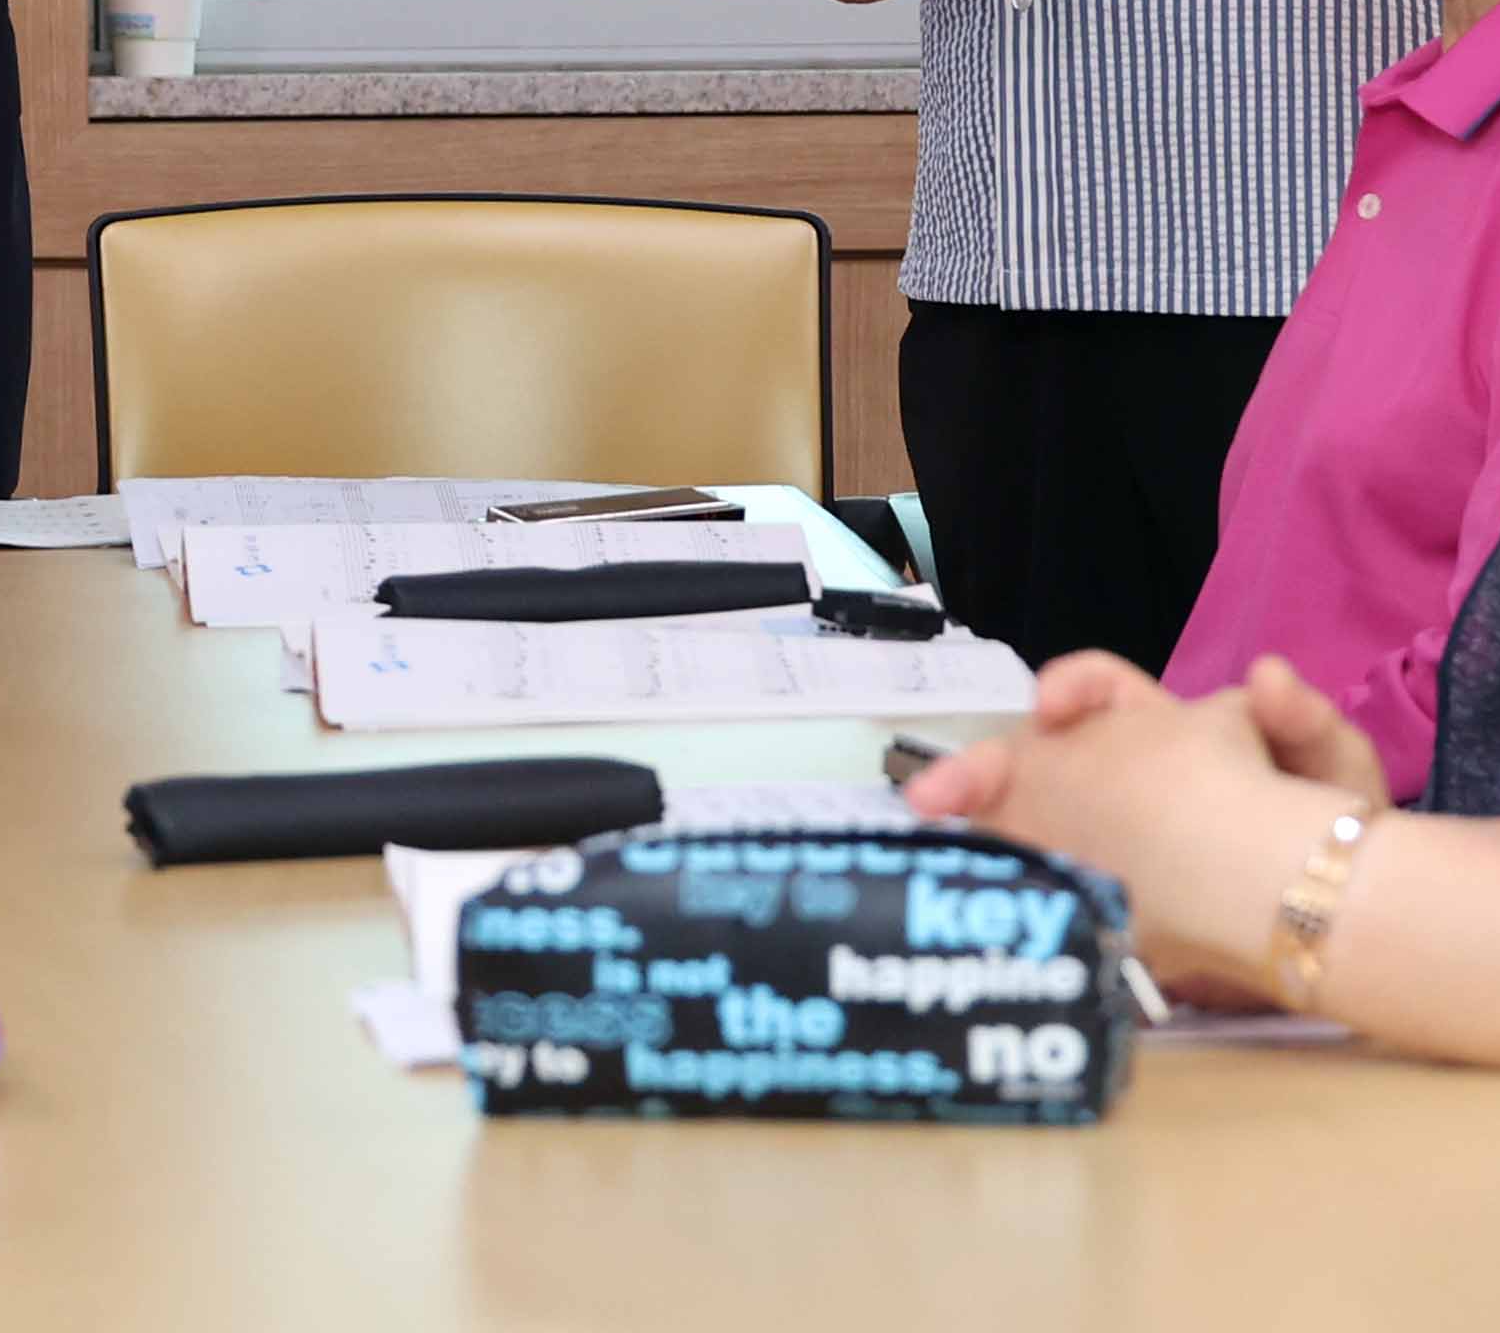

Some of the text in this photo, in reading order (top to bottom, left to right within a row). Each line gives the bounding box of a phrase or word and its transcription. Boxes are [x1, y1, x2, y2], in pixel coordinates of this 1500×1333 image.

[904, 873, 1077, 961] key
[828, 942, 1089, 1013] happine
[715, 984, 846, 1051] the
[624, 1036, 960, 1101] happiness.
[966, 1023, 1090, 1083] no
